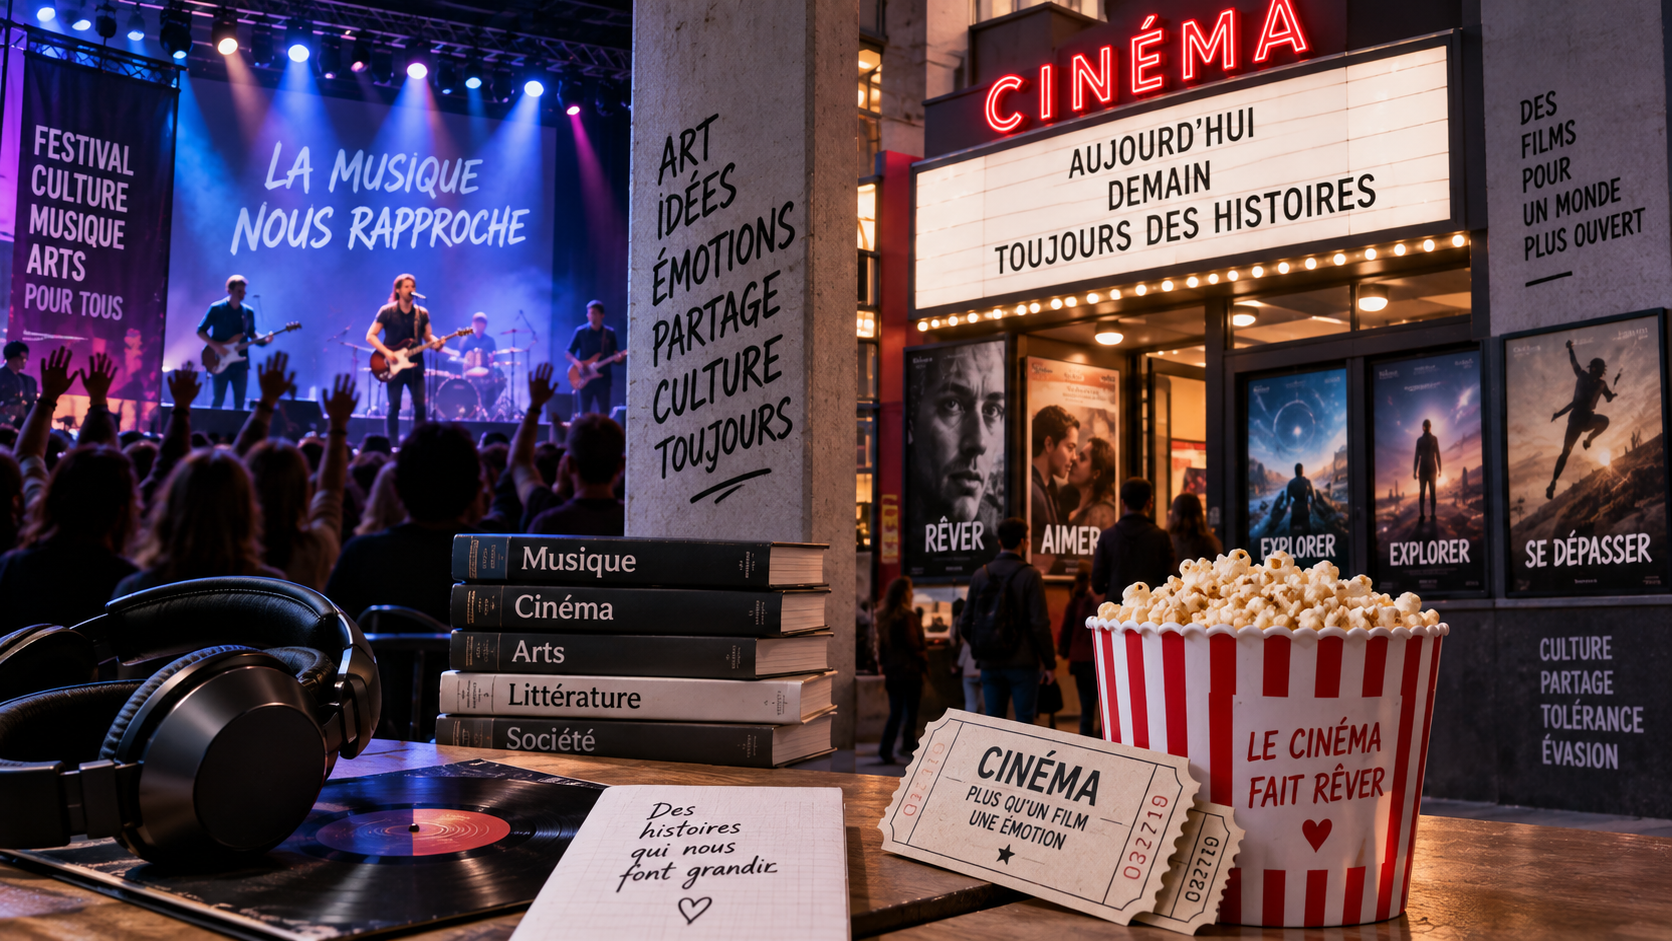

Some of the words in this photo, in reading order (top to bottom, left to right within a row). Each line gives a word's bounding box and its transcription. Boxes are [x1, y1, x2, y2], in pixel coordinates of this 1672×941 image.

[984, 0, 1308, 132] CINÉMA
[1520, 90, 1558, 126] DES
[34, 124, 134, 176] FESTIVAL
[658, 113, 719, 186] ART
[1068, 106, 1256, 179] AUJOURD'HUI
[1521, 119, 1577, 159] FILMS
[264, 140, 313, 194] LA
[1108, 160, 1212, 212] DEMAIN
[1522, 156, 1572, 194] POUR
[31, 164, 129, 213] CULTURE
[1523, 197, 1548, 227] UN
[1556, 177, 1621, 218] MONDE
[29, 203, 126, 250] MUSIQUE
[230, 201, 335, 256] NOUS
[348, 205, 531, 250] RAPPROCHE
[994, 219, 1132, 275] TOUJOURS
[1146, 206, 1200, 247] DES
[1214, 173, 1377, 235] HISTOIRES
[1524, 227, 1568, 262] PLUS
[1574, 207, 1646, 248] OUVERT
[26, 243, 87, 282] ARTS
[652, 201, 796, 306] ÉMOTIONS
[24, 283, 73, 315] POUR
[79, 291, 123, 321] TOUS
[652, 269, 781, 367] PARTAGE
[653, 334, 783, 424] CULTURE
[654, 396, 793, 480] TOUJOURS
[925, 515, 985, 553] RÊVER
[1040, 524, 1101, 555] AIMER
[1260, 533, 1336, 561] EXPLORER
[1389, 538, 1471, 567] EXPLORER
[1524, 539, 1547, 569] SE
[1553, 529, 1653, 568] DÉPASSER
[521, 546, 637, 578] Musique
[514, 593, 614, 621] Cinéma
[511, 639, 565, 664] Arts
[1539, 635, 1613, 662] CULTURE
[508, 682, 642, 709] Littérature
[1540, 670, 1614, 696] PARTAGE
[1541, 699, 1645, 734] TOLÉRANCE
[506, 726, 596, 752] Société
[1246, 729, 1280, 763] LE
[1289, 716, 1382, 759] CINÉMA
[1542, 733, 1620, 771] ÉVASION
[977, 745, 1101, 807] CINÉMA
[1248, 774, 1305, 809] FAIT
[1312, 763, 1386, 805] RÊVER
[646, 801, 696, 821] Des
[966, 785, 1002, 808] PLUS
[1004, 794, 1050, 821] QU'UN
[1052, 806, 1090, 833] FILM
[639, 820, 742, 840] histoires
[969, 809, 997, 831] UNE
[999, 814, 1067, 851] ÉMOTION
[1123, 794, 1169, 881] 032719
[630, 843, 671, 866] qui
[682, 841, 736, 856] nous
[616, 862, 677, 893] font
[681, 855, 779, 890] grandir
